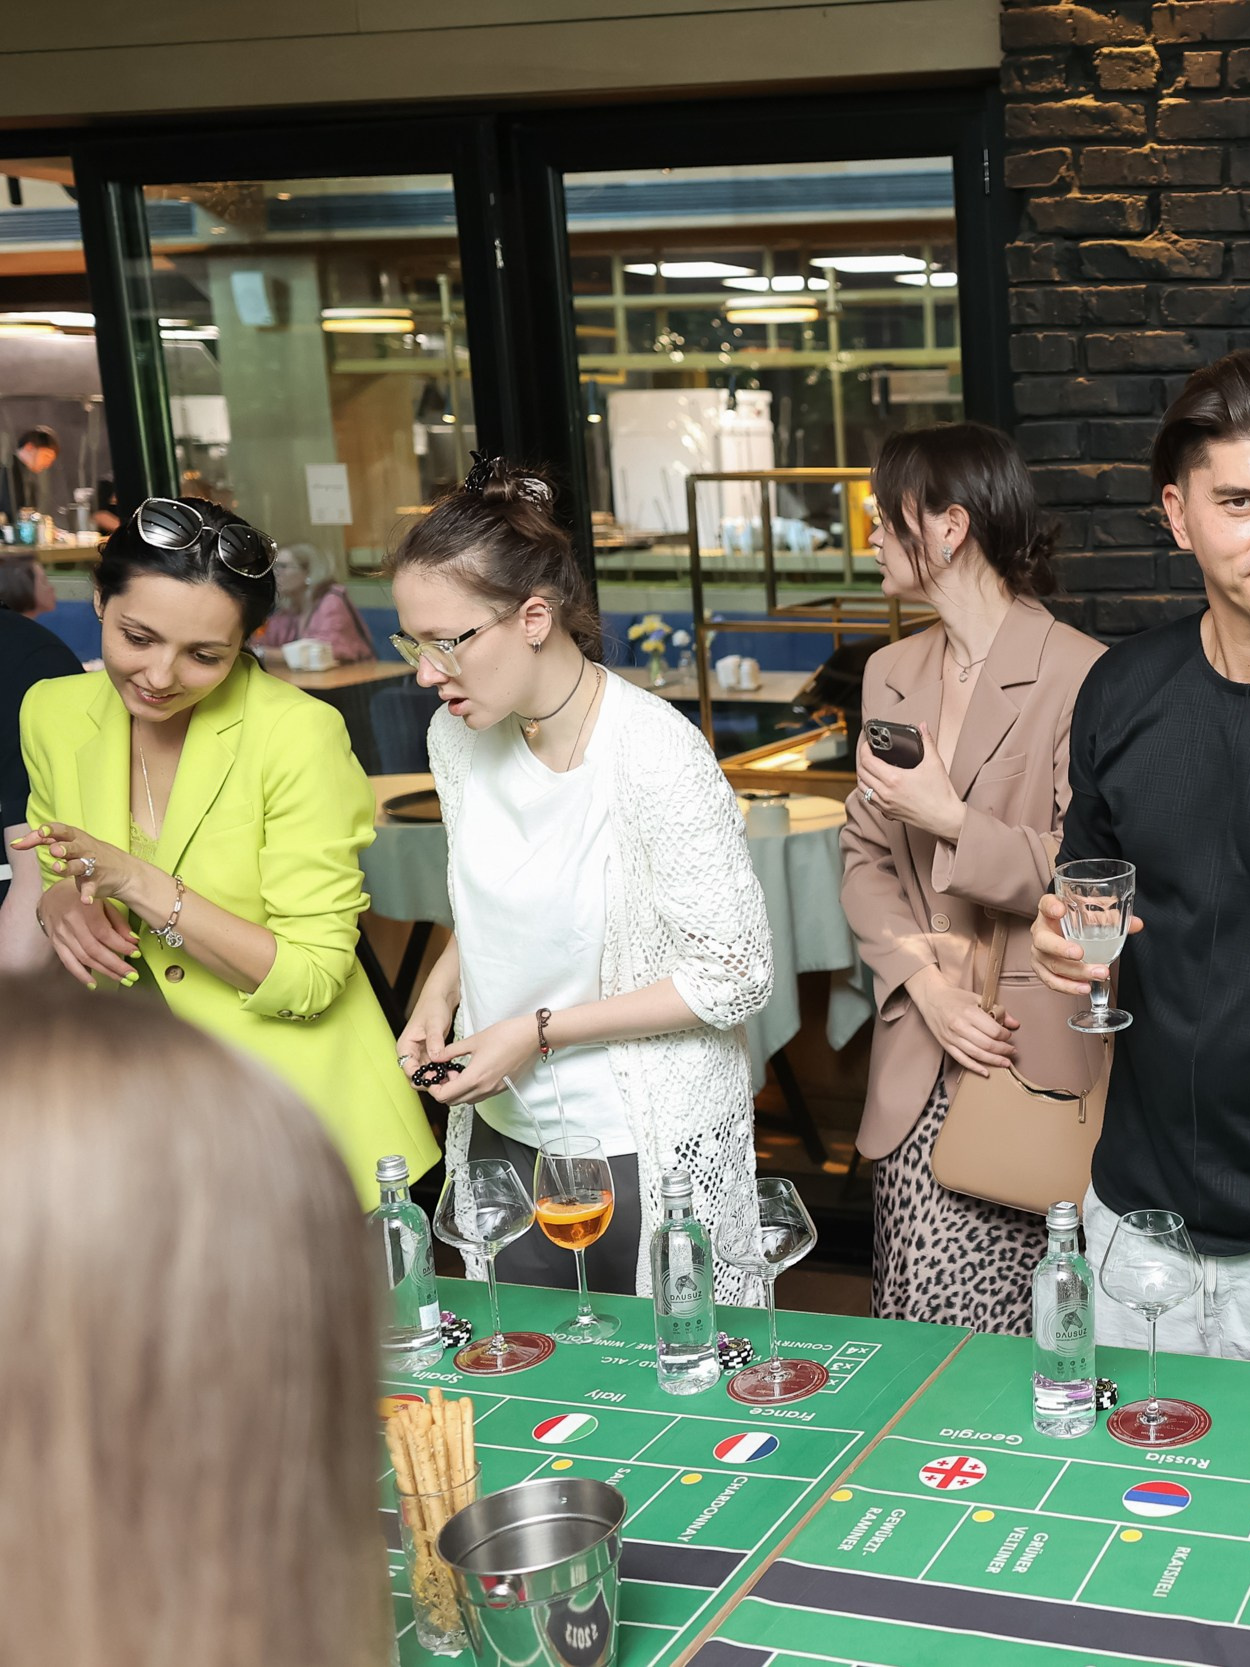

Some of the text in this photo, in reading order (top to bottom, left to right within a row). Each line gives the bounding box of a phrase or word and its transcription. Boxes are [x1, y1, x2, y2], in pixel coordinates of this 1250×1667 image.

[670, 1291, 702, 1301] DAUSUZ
[1056, 1328, 1087, 1338] DAUSUZ
[772, 1339, 869, 1356] x4 COUNTRY
[600, 1356, 628, 1366] ALC.
[831, 1361, 855, 1372] x3
[412, 1370, 463, 1385] Spain
[584, 1389, 627, 1403] Italy
[750, 1406, 816, 1422] France
[938, 1428, 1023, 1446] Georgia
[1144, 1451, 1211, 1470] Russia
[677, 1476, 749, 1542] CHARDONNAY
[837, 1506, 883, 1552] RAMINER
[861, 1507, 907, 1557] GEWÜRZT-
[985, 1526, 1030, 1575] VELTLINER
[1012, 1531, 1049, 1574] GRÜNER
[1152, 1546, 1192, 1599] RKATSITELI
